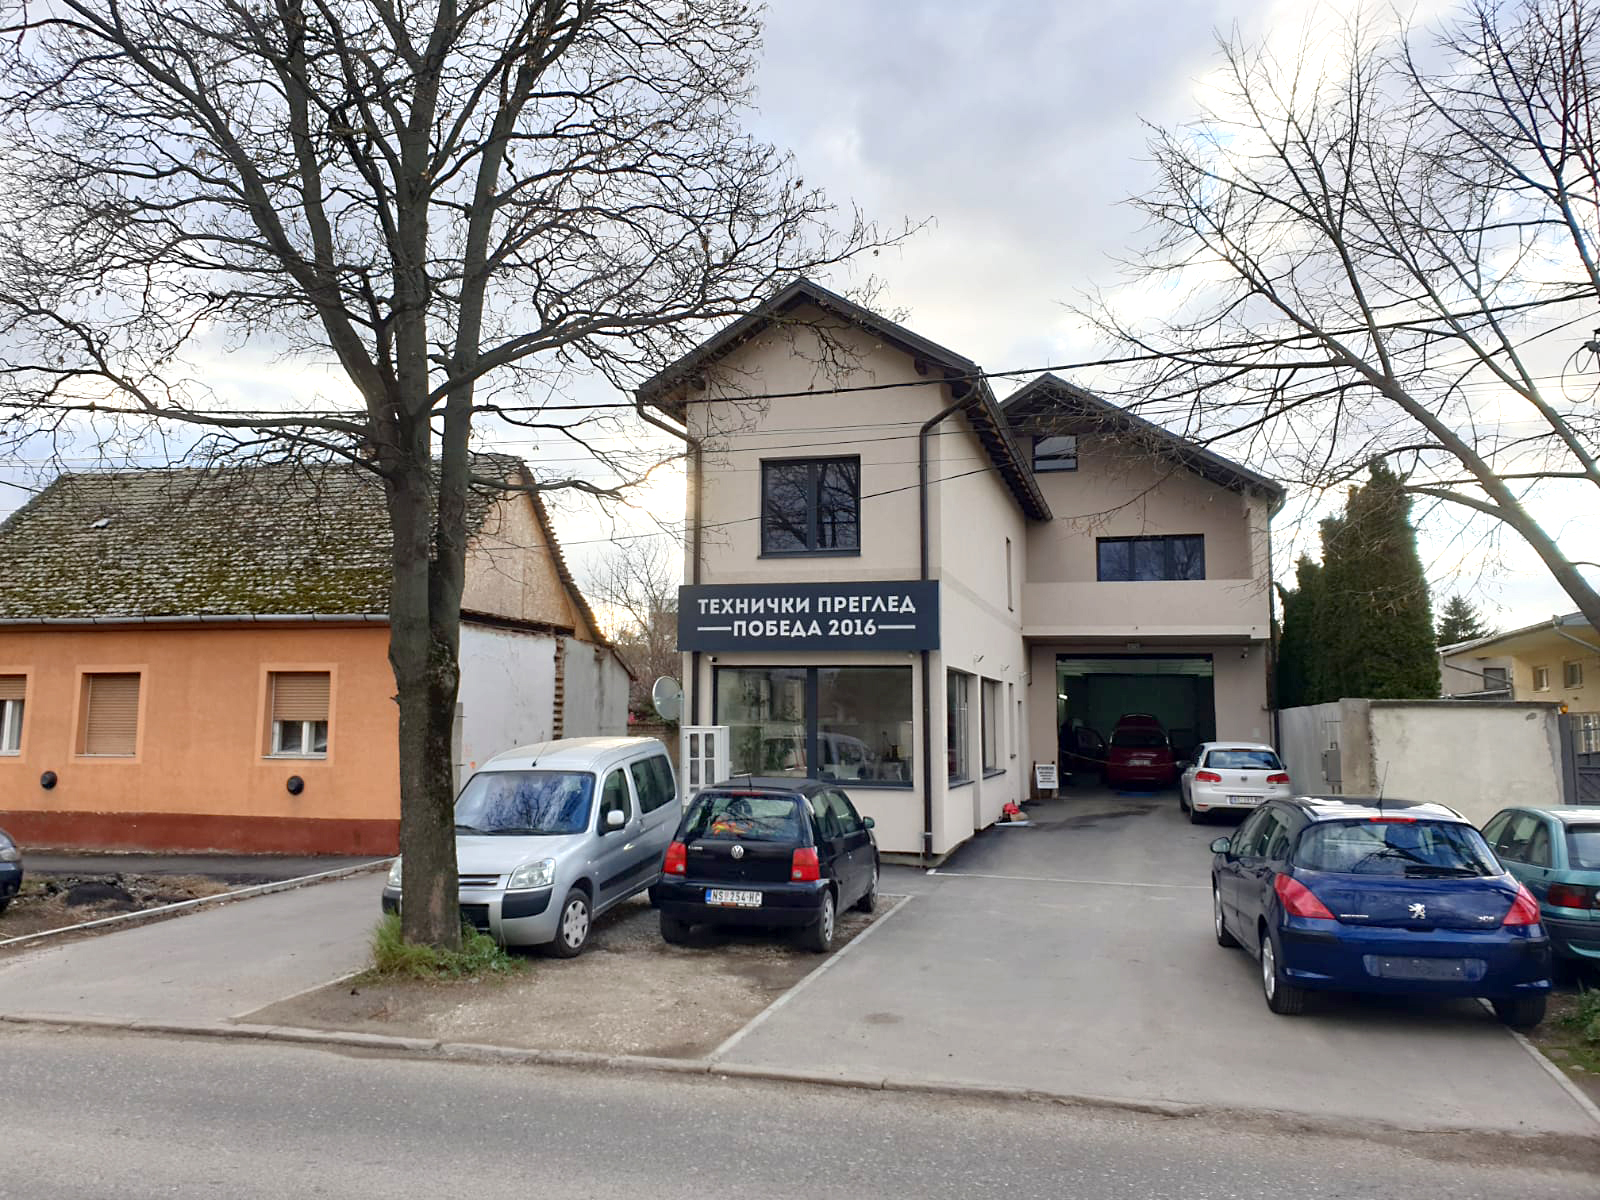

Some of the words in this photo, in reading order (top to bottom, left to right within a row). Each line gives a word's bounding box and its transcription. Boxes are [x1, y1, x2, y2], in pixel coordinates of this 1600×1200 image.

[698, 598, 810, 614] ТЕХНИЧКИ
[818, 596, 916, 613] ПРЕГЛЕД
[733, 620, 823, 638] ПОБЕДА
[828, 619, 877, 636] 2016
